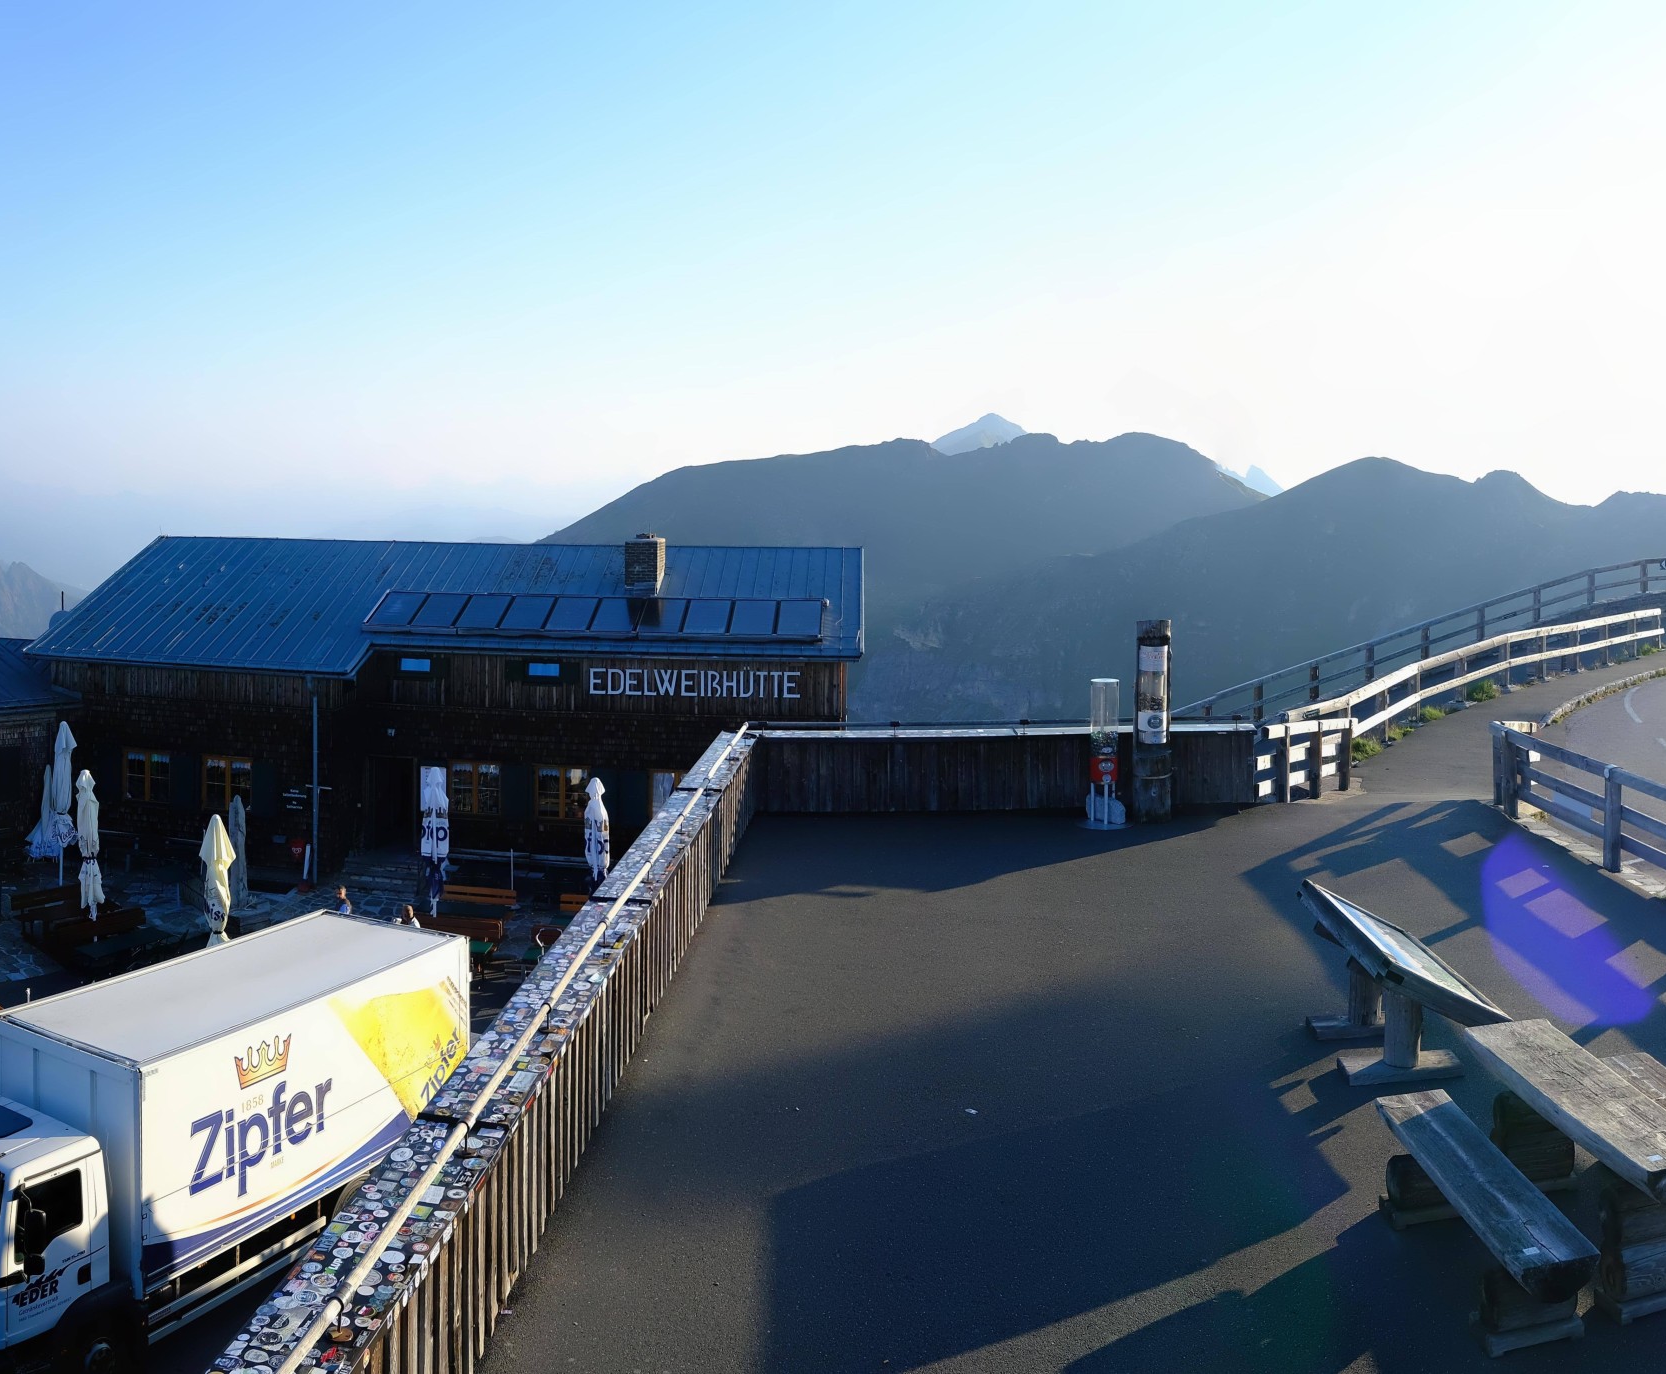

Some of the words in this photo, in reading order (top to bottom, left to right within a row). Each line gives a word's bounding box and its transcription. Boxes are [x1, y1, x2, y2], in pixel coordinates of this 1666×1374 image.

[241, 1094, 264, 1114] 1858
[189, 1078, 332, 1197] Zipfer
[18, 1279, 59, 1308] EDER
